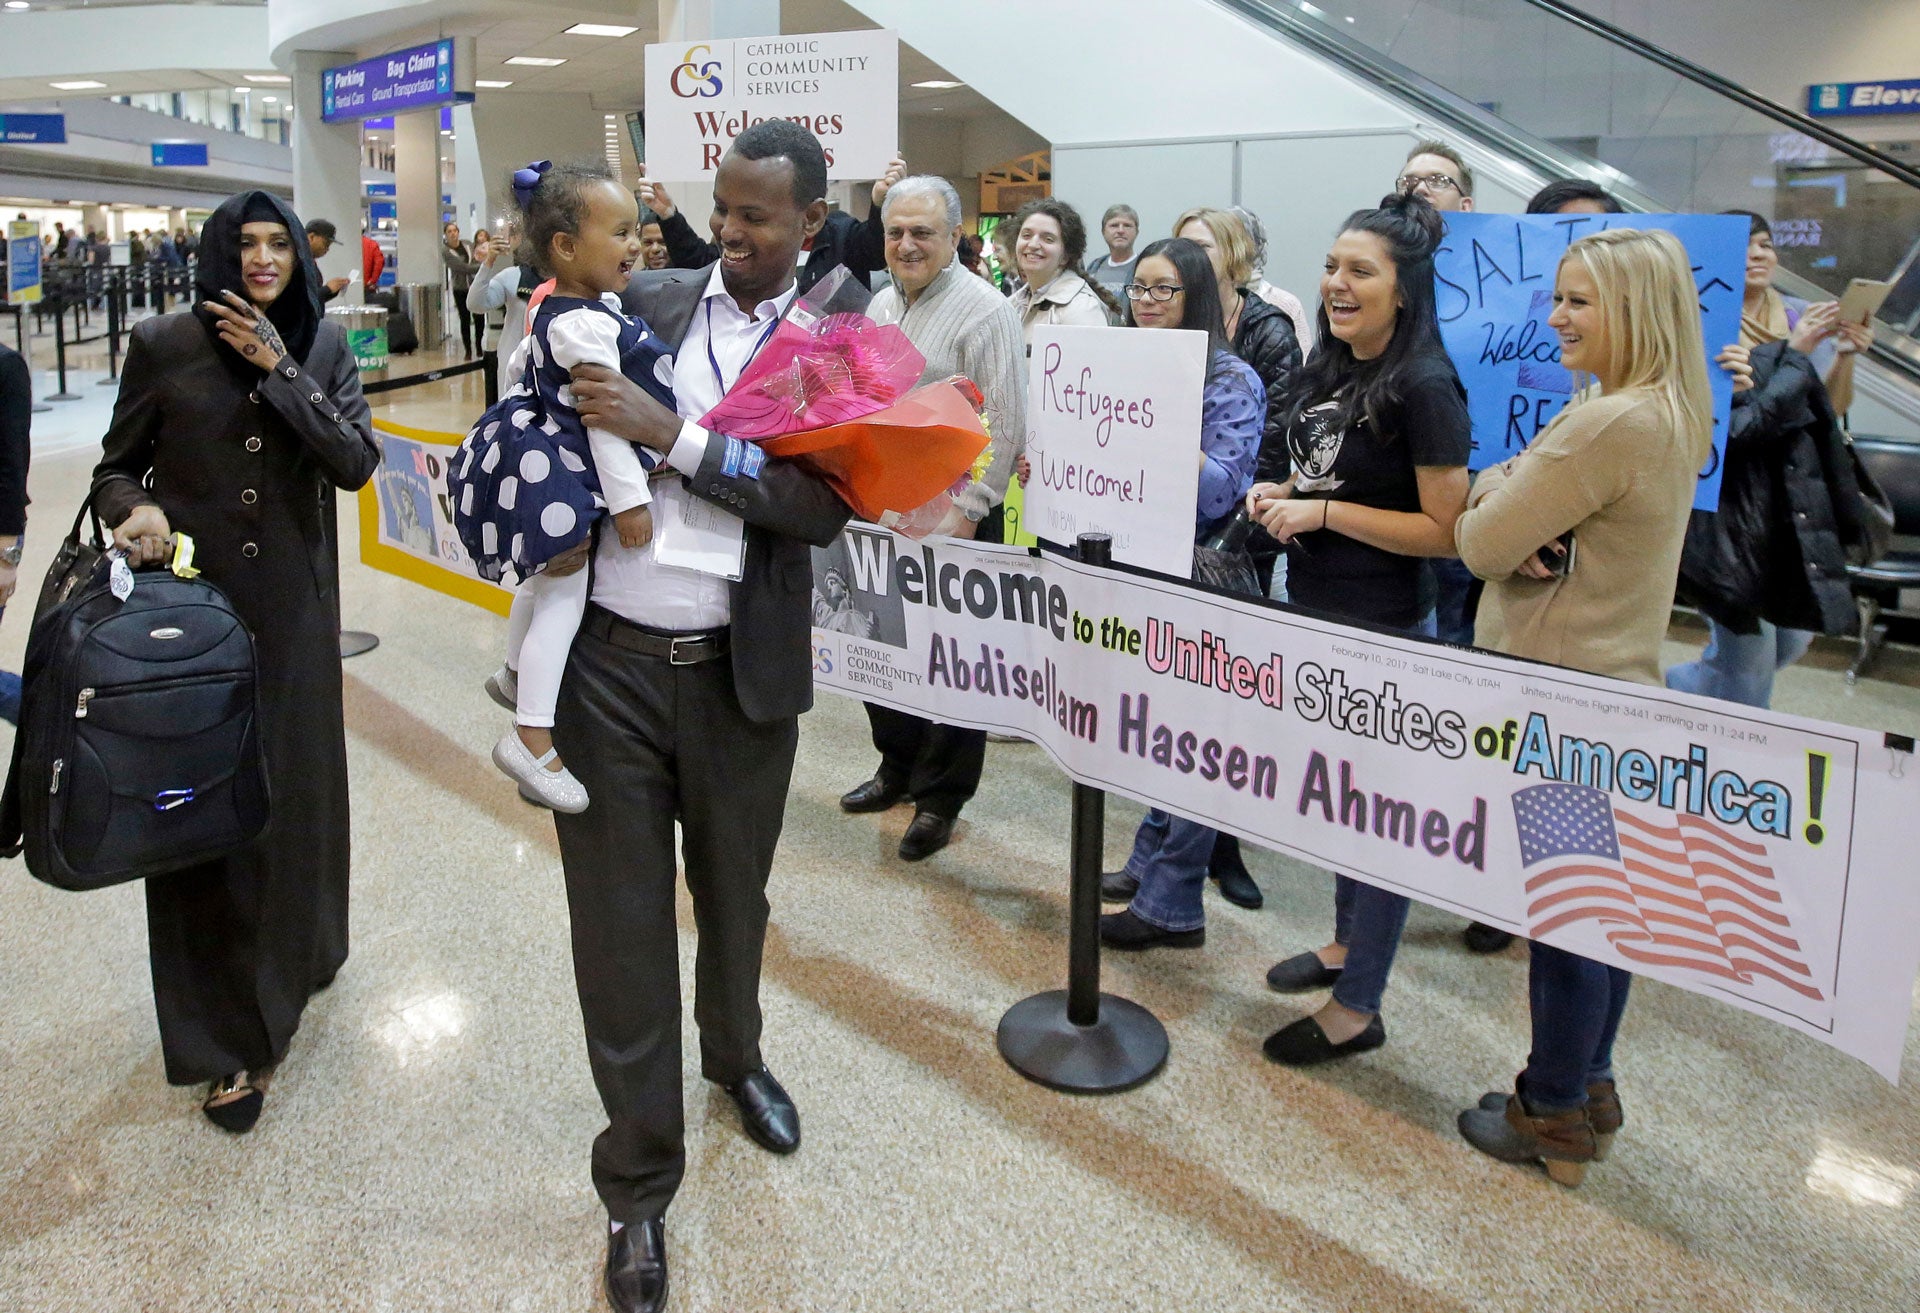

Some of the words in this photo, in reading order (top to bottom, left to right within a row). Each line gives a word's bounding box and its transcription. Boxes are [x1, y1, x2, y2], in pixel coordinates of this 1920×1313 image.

[746, 41, 819, 57] CATHOLIC
[386, 60, 406, 78] Bag
[407, 52, 436, 73] Claim
[746, 56, 869, 77] COMMUNITY
[334, 69, 366, 90] Parking
[371, 84, 393, 101] Ground
[393, 77, 436, 97] Transportation
[746, 79, 820, 96] SERVICES
[335, 95, 351, 109] Rental
[351, 91, 365, 106] Cars
[693, 109, 844, 138] Welmes
[1042, 342, 1154, 448] Refugees
[1041, 450, 1144, 503] Welcome!
[845, 529, 1068, 642] Welcome
[1072, 610, 1094, 645] to
[1100, 615, 1142, 657] the
[1145, 616, 1284, 712] United
[1292, 661, 1468, 760] States
[1474, 720, 1518, 761] of
[846, 644, 892, 663] CATHOLIC
[1331, 644, 1369, 661] February
[1386, 657, 1408, 670] 2017
[847, 656, 923, 686] COMMUNITY
[847, 670, 894, 691] SERVICES
[1412, 662, 1430, 676] Salt
[1431, 668, 1453, 680] Lake
[1477, 677, 1501, 690] UTAH
[1521, 685, 1553, 700] United
[1555, 691, 1590, 708] Airlines
[1592, 699, 1621, 715] Flight
[1623, 706, 1651, 720] 3441
[1654, 713, 1695, 730] arriving
[1697, 719, 1709, 732] at
[1712, 723, 1746, 741] 11:24
[1748, 731, 1769, 745] PM
[928, 631, 1099, 744] Abdisellam
[1117, 692, 1278, 801] Hassen
[1297, 748, 1489, 874] Ahmed
